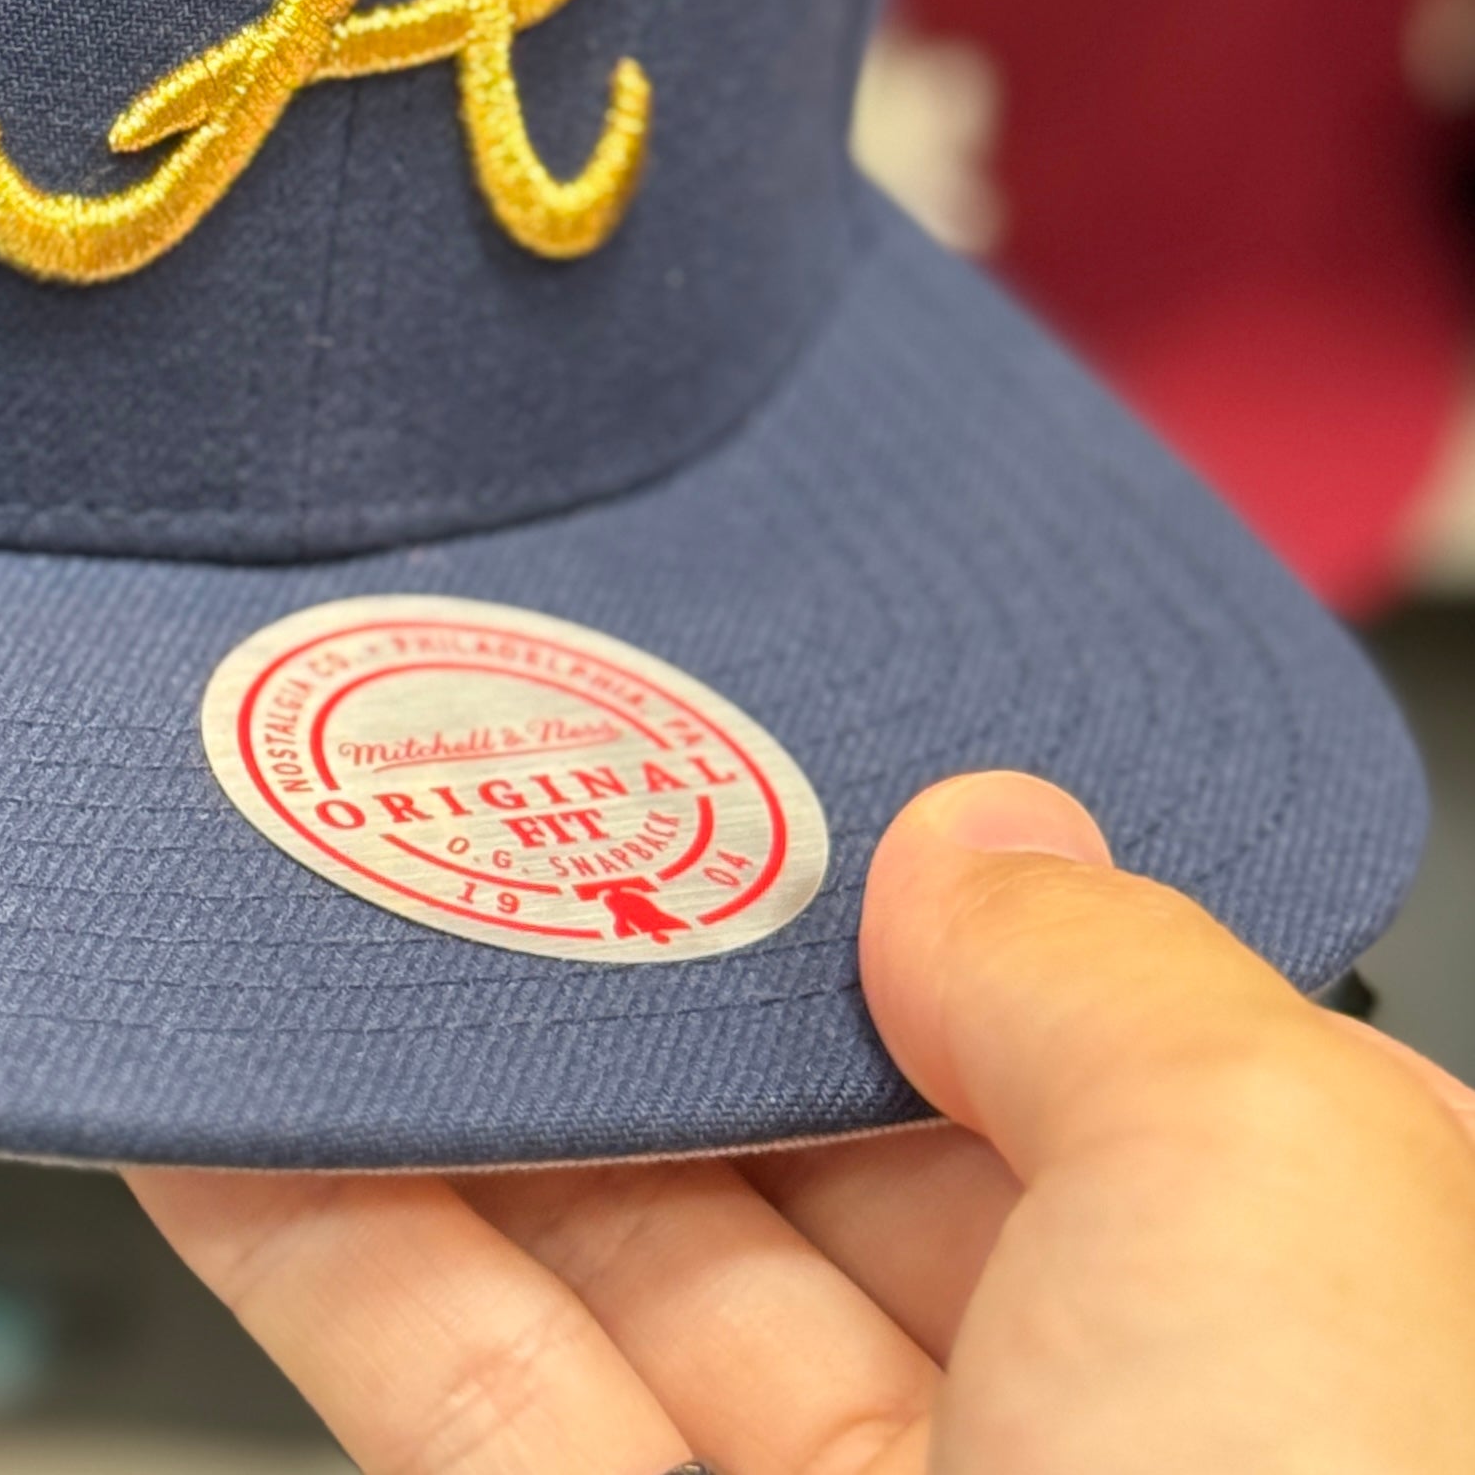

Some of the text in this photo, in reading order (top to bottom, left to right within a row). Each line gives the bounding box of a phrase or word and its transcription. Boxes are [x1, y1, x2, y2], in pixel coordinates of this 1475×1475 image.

[264, 676, 314, 792] NOSTALGIA
[337, 727, 494, 766] Mitchell
[526, 718, 623, 746] Ness
[314, 755, 737, 831] ORIGINAL
[500, 808, 612, 848] FIT
[548, 810, 682, 878] SNAPBACK
[456, 848, 754, 915] 19 04
